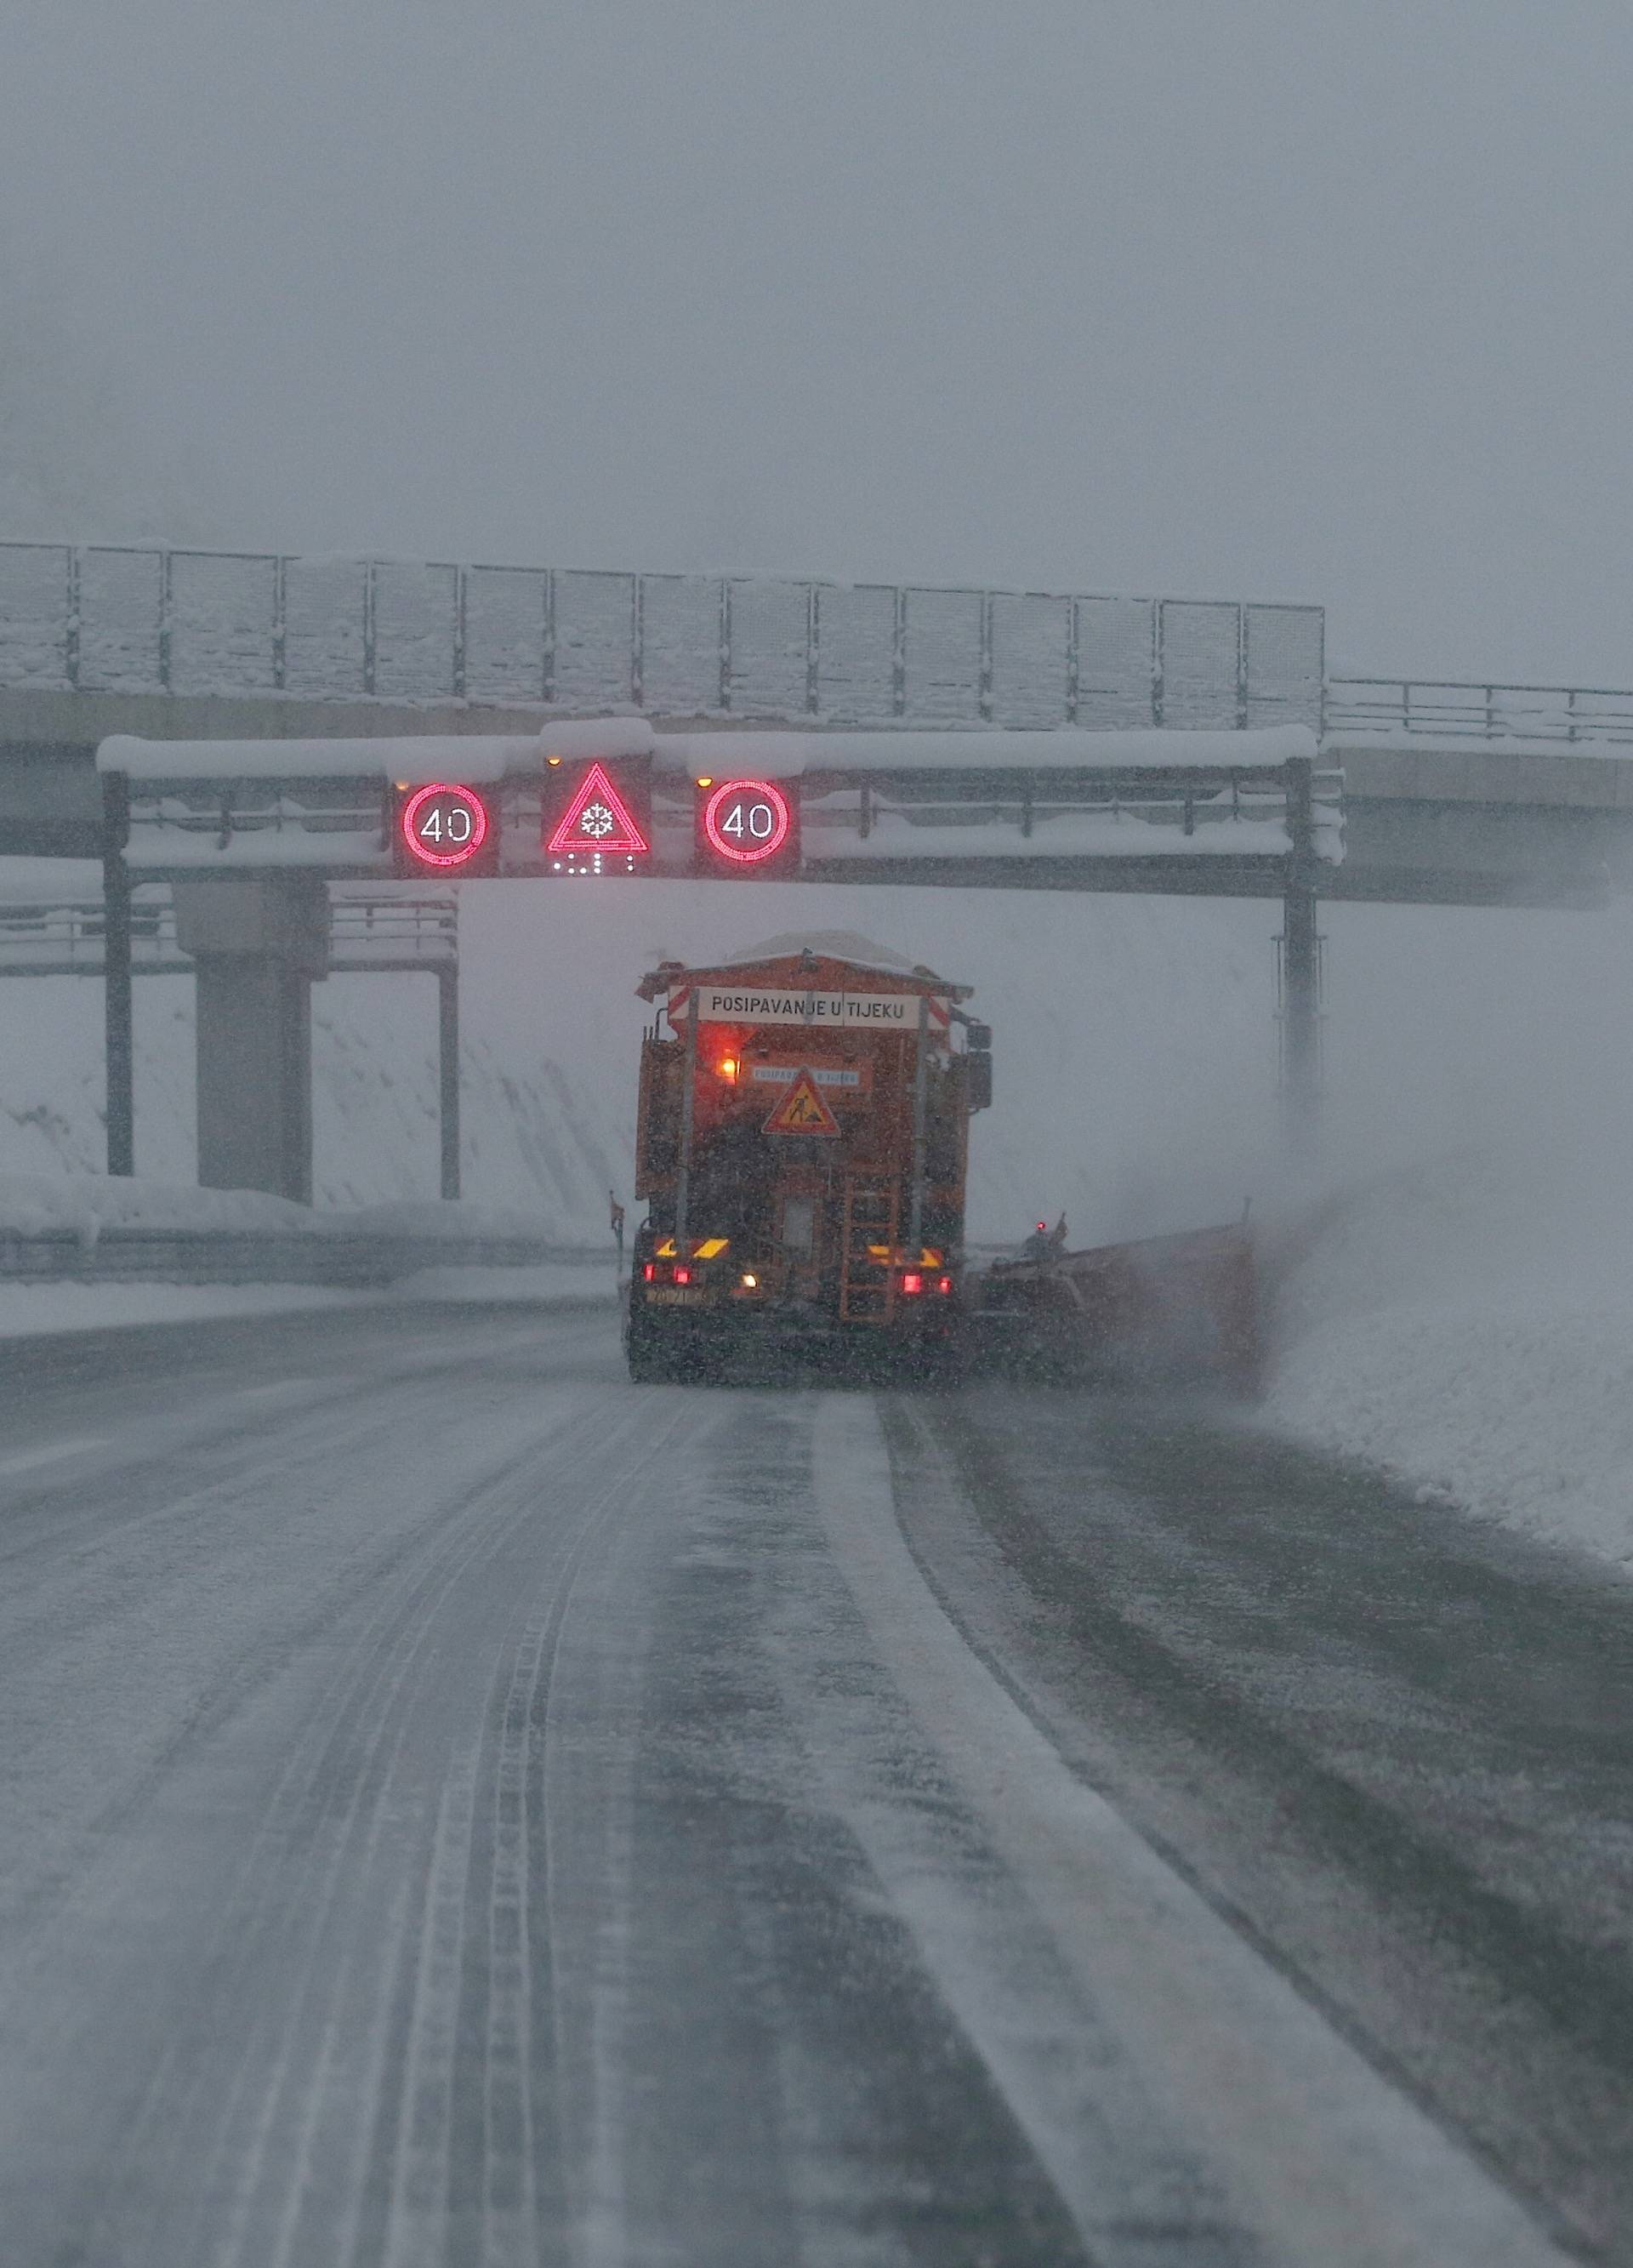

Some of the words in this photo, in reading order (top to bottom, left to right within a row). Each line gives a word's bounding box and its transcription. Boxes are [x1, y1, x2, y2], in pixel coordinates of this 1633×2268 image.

[420, 808, 470, 842] 40
[721, 803, 772, 838] 40
[712, 996, 827, 1016] POSIPAVANJE
[831, 1000, 841, 1017] U
[846, 1002, 904, 1019] TIJEKU
